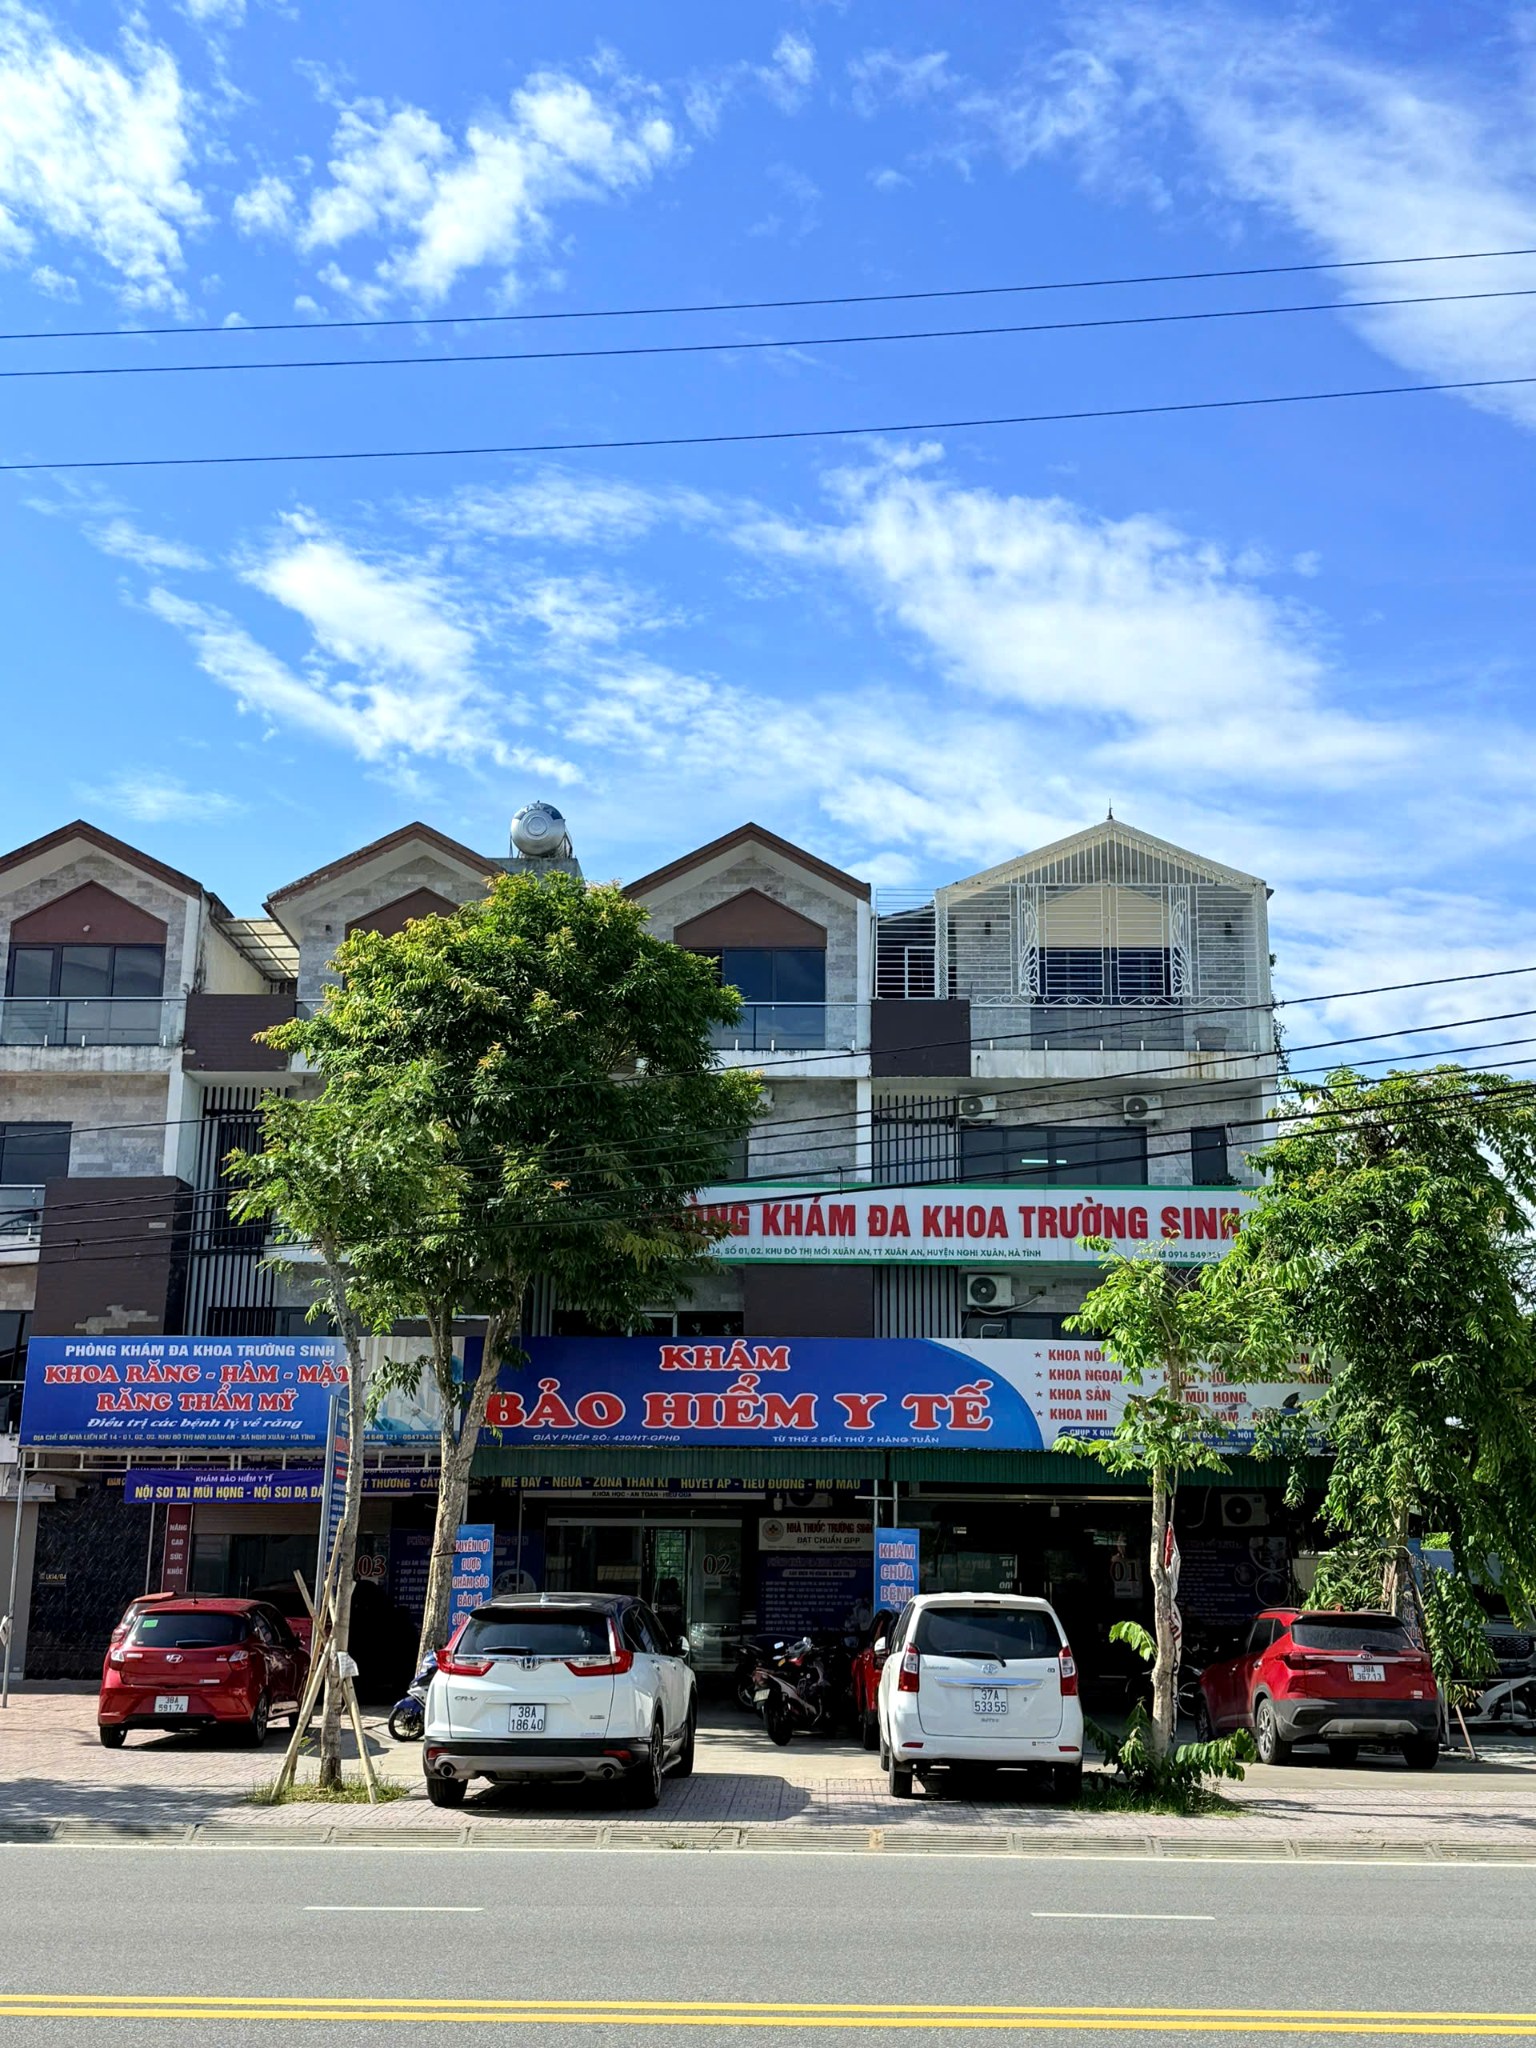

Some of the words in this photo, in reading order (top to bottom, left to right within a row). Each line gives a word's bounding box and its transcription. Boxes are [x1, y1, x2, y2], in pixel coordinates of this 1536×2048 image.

[762, 1196, 856, 1237] KHÁM
[868, 1204, 911, 1237] ĐA
[922, 1205, 1009, 1239] KHOA
[1018, 1196, 1148, 1240] TRƯỜNG
[1160, 1206, 1240, 1240] SINH
[765, 1247, 783, 1255] KHU
[800, 1247, 812, 1258] THỊ
[814, 1246, 830, 1256] MỚI
[832, 1246, 855, 1256] XUÂN
[857, 1248, 871, 1257] AN,
[873, 1248, 882, 1256] TT
[884, 1247, 908, 1257] XUÂN
[910, 1248, 925, 1258] AN,
[927, 1248, 954, 1259] HUYỆN
[957, 1249, 978, 1257] NGHI
[980, 1248, 1006, 1259] XUÂN,
[1008, 1248, 1020, 1258] HÀ
[1022, 1248, 1041, 1258] TĨNH
[65, 1342, 116, 1357] PHÒNG
[120, 1342, 164, 1357] KHÁM
[168, 1344, 189, 1357] ĐA
[193, 1344, 235, 1357] KHOA
[237, 1342, 295, 1357] TRƯỜNG
[299, 1345, 335, 1357] SINH
[659, 1339, 791, 1371] KHÁM
[1048, 1349, 1081, 1361] KHOA
[1084, 1347, 1106, 1364] NỘI
[44, 1365, 121, 1384] KHOA
[125, 1359, 202, 1384] RĂNG
[219, 1360, 280, 1384] HÀM
[297, 1359, 350, 1388] MẶT
[1049, 1369, 1081, 1381] KHOA
[1085, 1369, 1122, 1385] NGOẠI
[96, 1387, 173, 1412] RĂNG
[178, 1383, 253, 1412] THẨM
[257, 1388, 299, 1412] MỸ
[1049, 1388, 1082, 1401] KHOA
[1086, 1385, 1111, 1401] SẢN
[485, 1378, 626, 1429] BẢO
[642, 1373, 819, 1430] HIỂM
[833, 1393, 887, 1430] Y
[901, 1379, 993, 1431] TẾ
[1050, 1408, 1082, 1421] KHOA
[1086, 1409, 1107, 1421] NHI
[87, 1416, 124, 1428] Điều
[126, 1418, 148, 1430] trị
[150, 1417, 177, 1428] các
[180, 1417, 220, 1430] bệnh
[224, 1418, 240, 1429] lý
[243, 1416, 261, 1428] về
[263, 1418, 303, 1429] răng
[561, 1433, 590, 1441] PHÉP
[773, 1434, 786, 1443] TỪ
[788, 1434, 809, 1443] THỨ
[821, 1434, 842, 1443] ĐẾN
[844, 1434, 866, 1443] THỨ
[877, 1435, 909, 1443] HÀNG
[195, 1474, 218, 1483] KHÁM
[220, 1473, 237, 1483] BẢO
[238, 1473, 257, 1483] HIỂM
[258, 1475, 264, 1483] Y
[593, 1477, 622, 1488] ZONA
[135, 1486, 153, 1500] NỘI
[156, 1487, 173, 1498] SOI
[176, 1487, 191, 1498] TAI
[193, 1485, 213, 1498] MŨI
[216, 1487, 244, 1500] HỌNG
[254, 1486, 271, 1500] NỘI
[275, 1487, 291, 1498] SOI
[294, 1487, 307, 1500] DẠ
[879, 1541, 916, 1559] KHÁM
[357, 1555, 387, 1577] 03
[703, 1553, 731, 1576] 02
[881, 1562, 914, 1580] CHỮA
[1111, 1561, 1138, 1582] 01
[475, 1574, 489, 1588] SÓC
[880, 1583, 914, 1605] BỆNH
[981, 1689, 999, 1701] 37A
[158, 1704, 184, 1712] 591.74
[518, 1706, 537, 1719] 38A
[974, 1701, 1007, 1713] 533.55
[511, 1718, 544, 1732] 186.40
